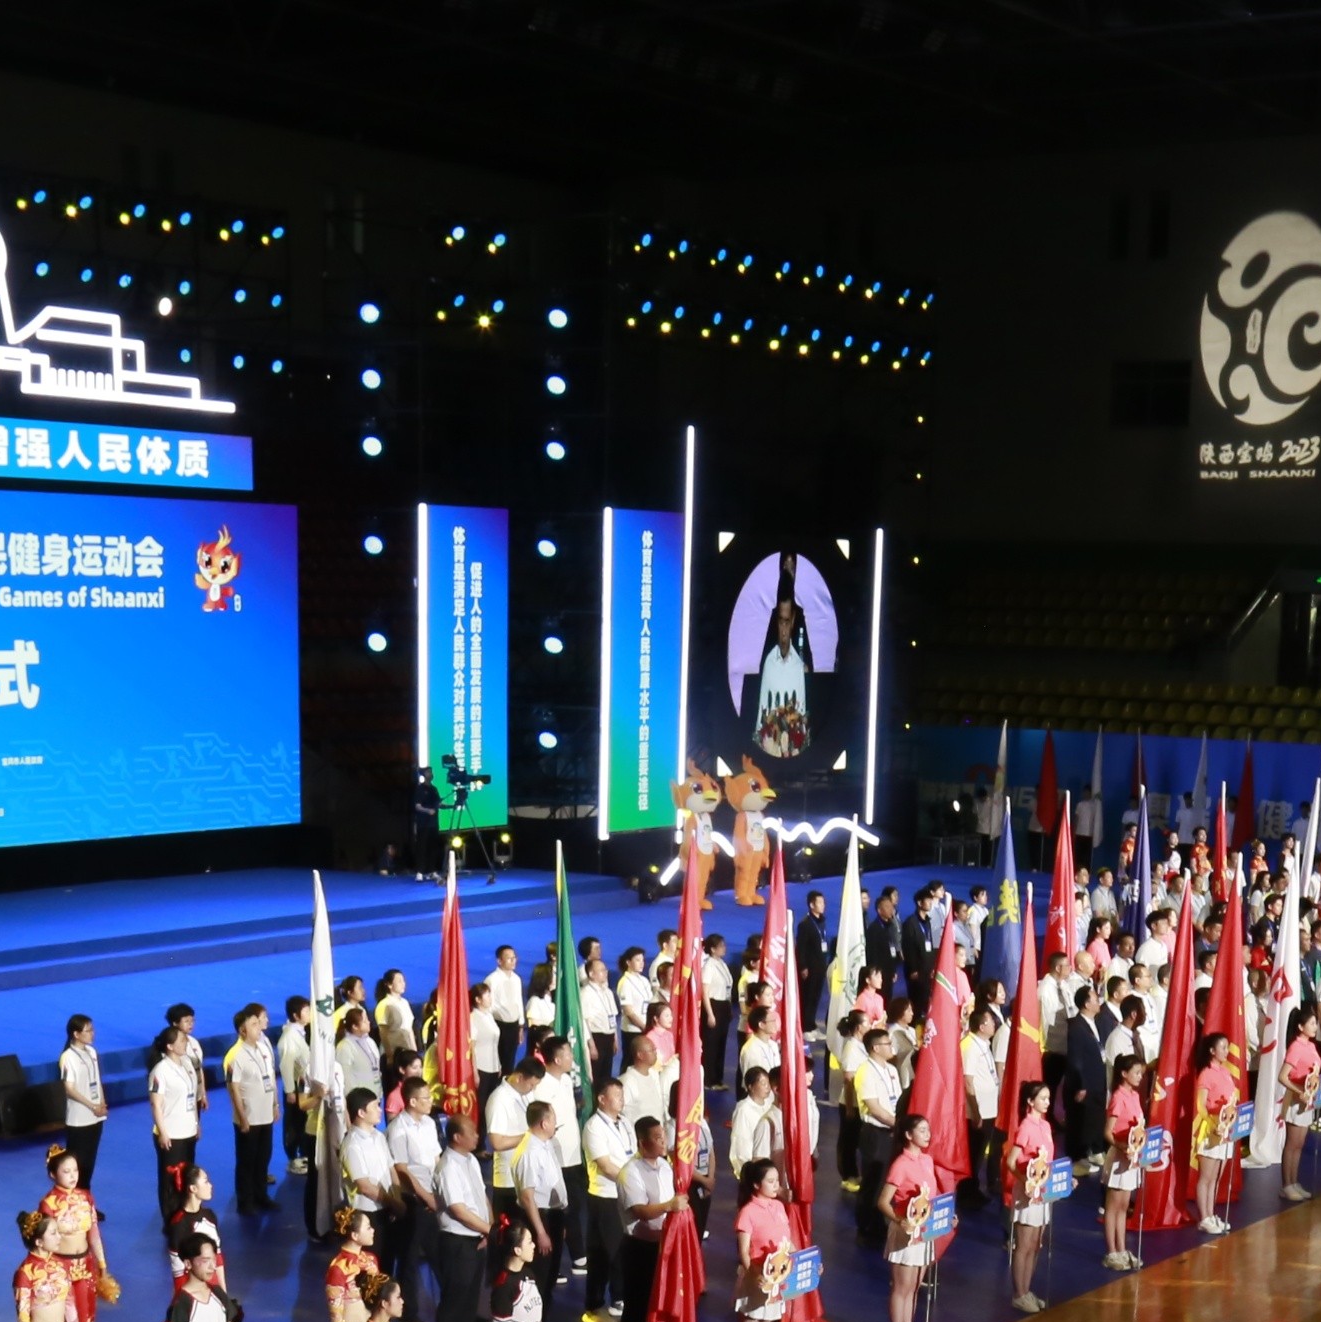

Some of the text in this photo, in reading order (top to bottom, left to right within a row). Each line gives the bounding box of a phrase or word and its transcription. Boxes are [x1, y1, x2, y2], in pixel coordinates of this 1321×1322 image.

[1200, 469, 1315, 480] BAOJI SHAANXI
[67, 586, 87, 609] of
[90, 587, 165, 609] Shaanxi
